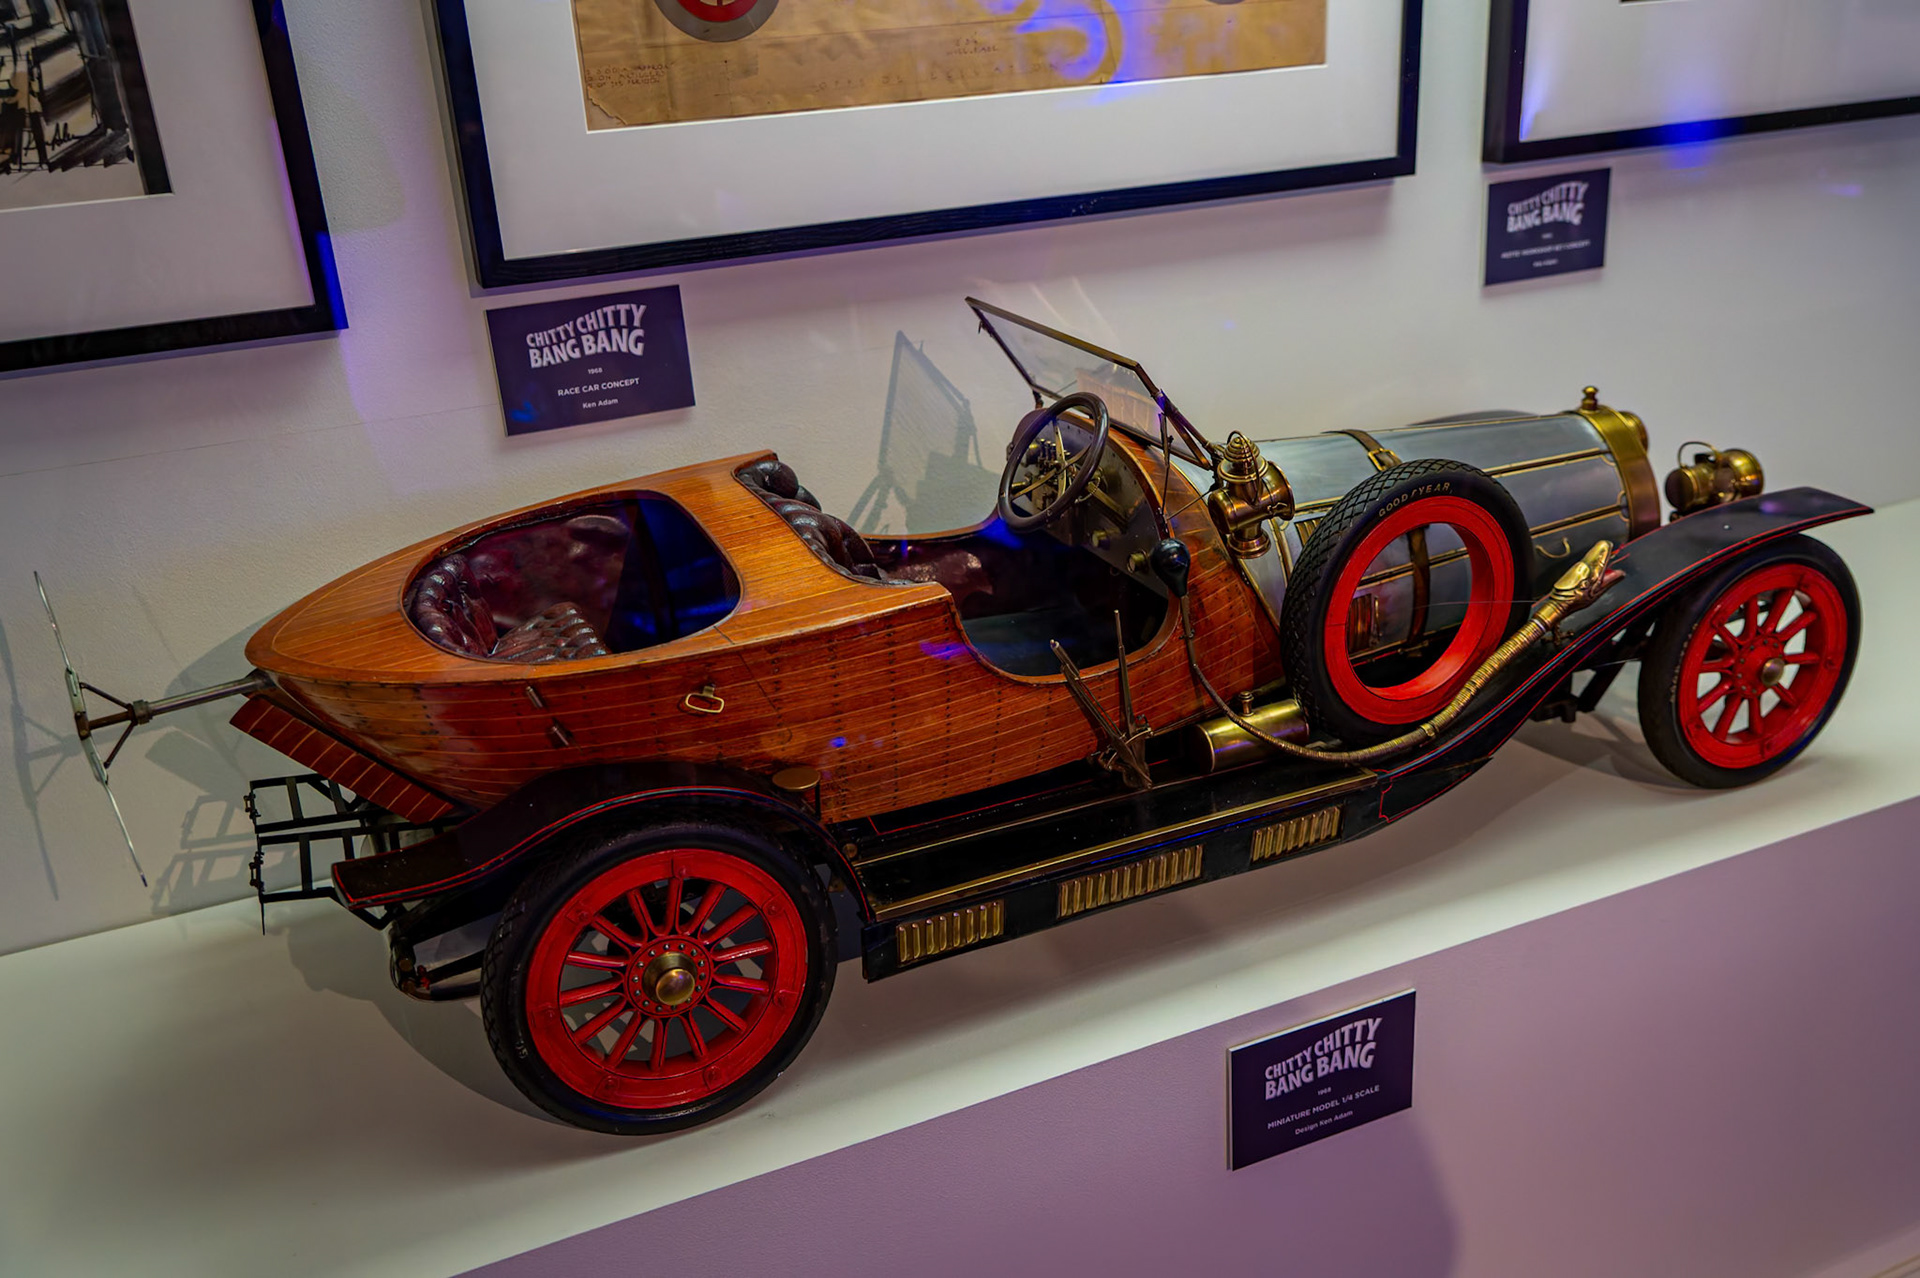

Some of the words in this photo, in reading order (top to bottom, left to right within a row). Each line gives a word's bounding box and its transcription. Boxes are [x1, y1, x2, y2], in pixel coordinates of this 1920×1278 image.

[1507, 194, 1540, 216] CHITTY
[1540, 181, 1589, 205] CHITTY
[1506, 209, 1541, 233] BANG
[1542, 202, 1585, 226] BANG
[526, 321, 576, 348] CHITTY
[576, 303, 647, 334] CHITTY
[529, 339, 581, 368] BANG
[581, 328, 645, 356] BANG
[557, 387, 580, 397] RACE
[582, 383, 600, 393] CAR
[601, 377, 640, 390] CONCEPT
[582, 401, 597, 409] Ken
[598, 398, 619, 407] Adam
[1264, 1046, 1313, 1080] CHITTY
[1314, 1017, 1383, 1056] CHITTY
[1265, 1065, 1315, 1100] BANG
[1316, 1041, 1377, 1078] BANG
[1267, 1109, 1311, 1130] MINIATURE
[1312, 1099, 1340, 1114] MODEL
[1354, 1085, 1380, 1099] SCALE
[1295, 1121, 1319, 1135] Design
[1319, 1117, 1333, 1127] Ken
[1333, 1110, 1354, 1121] Adam
